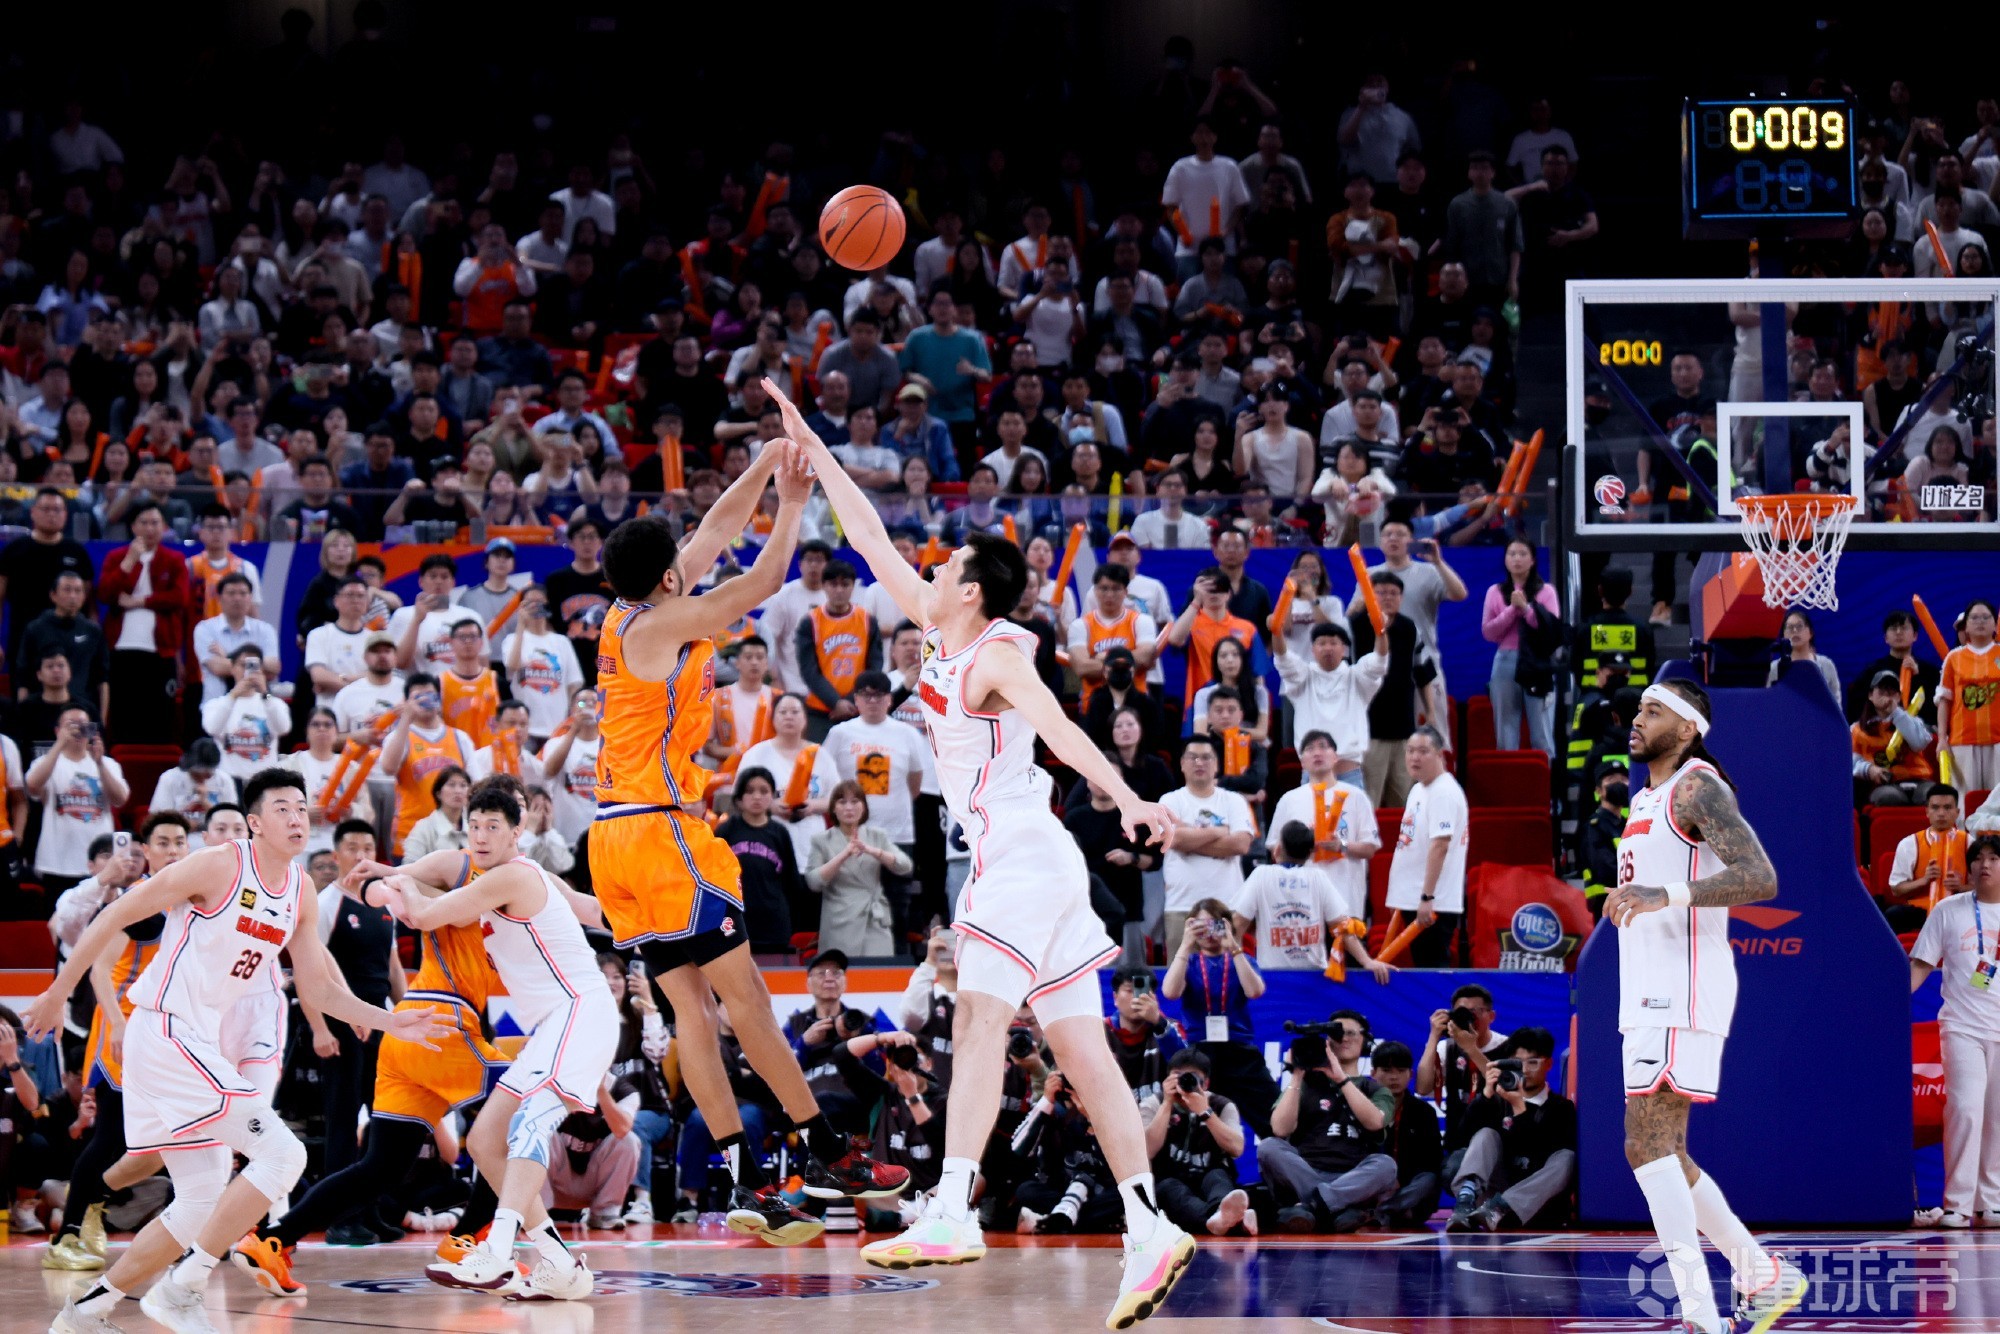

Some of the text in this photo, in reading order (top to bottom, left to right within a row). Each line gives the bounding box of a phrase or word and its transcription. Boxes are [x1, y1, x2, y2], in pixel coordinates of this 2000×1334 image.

[1922, 486, 1983, 509] 以城之名
[1619, 849, 1634, 886] 26
[230, 948, 263, 981] 28
